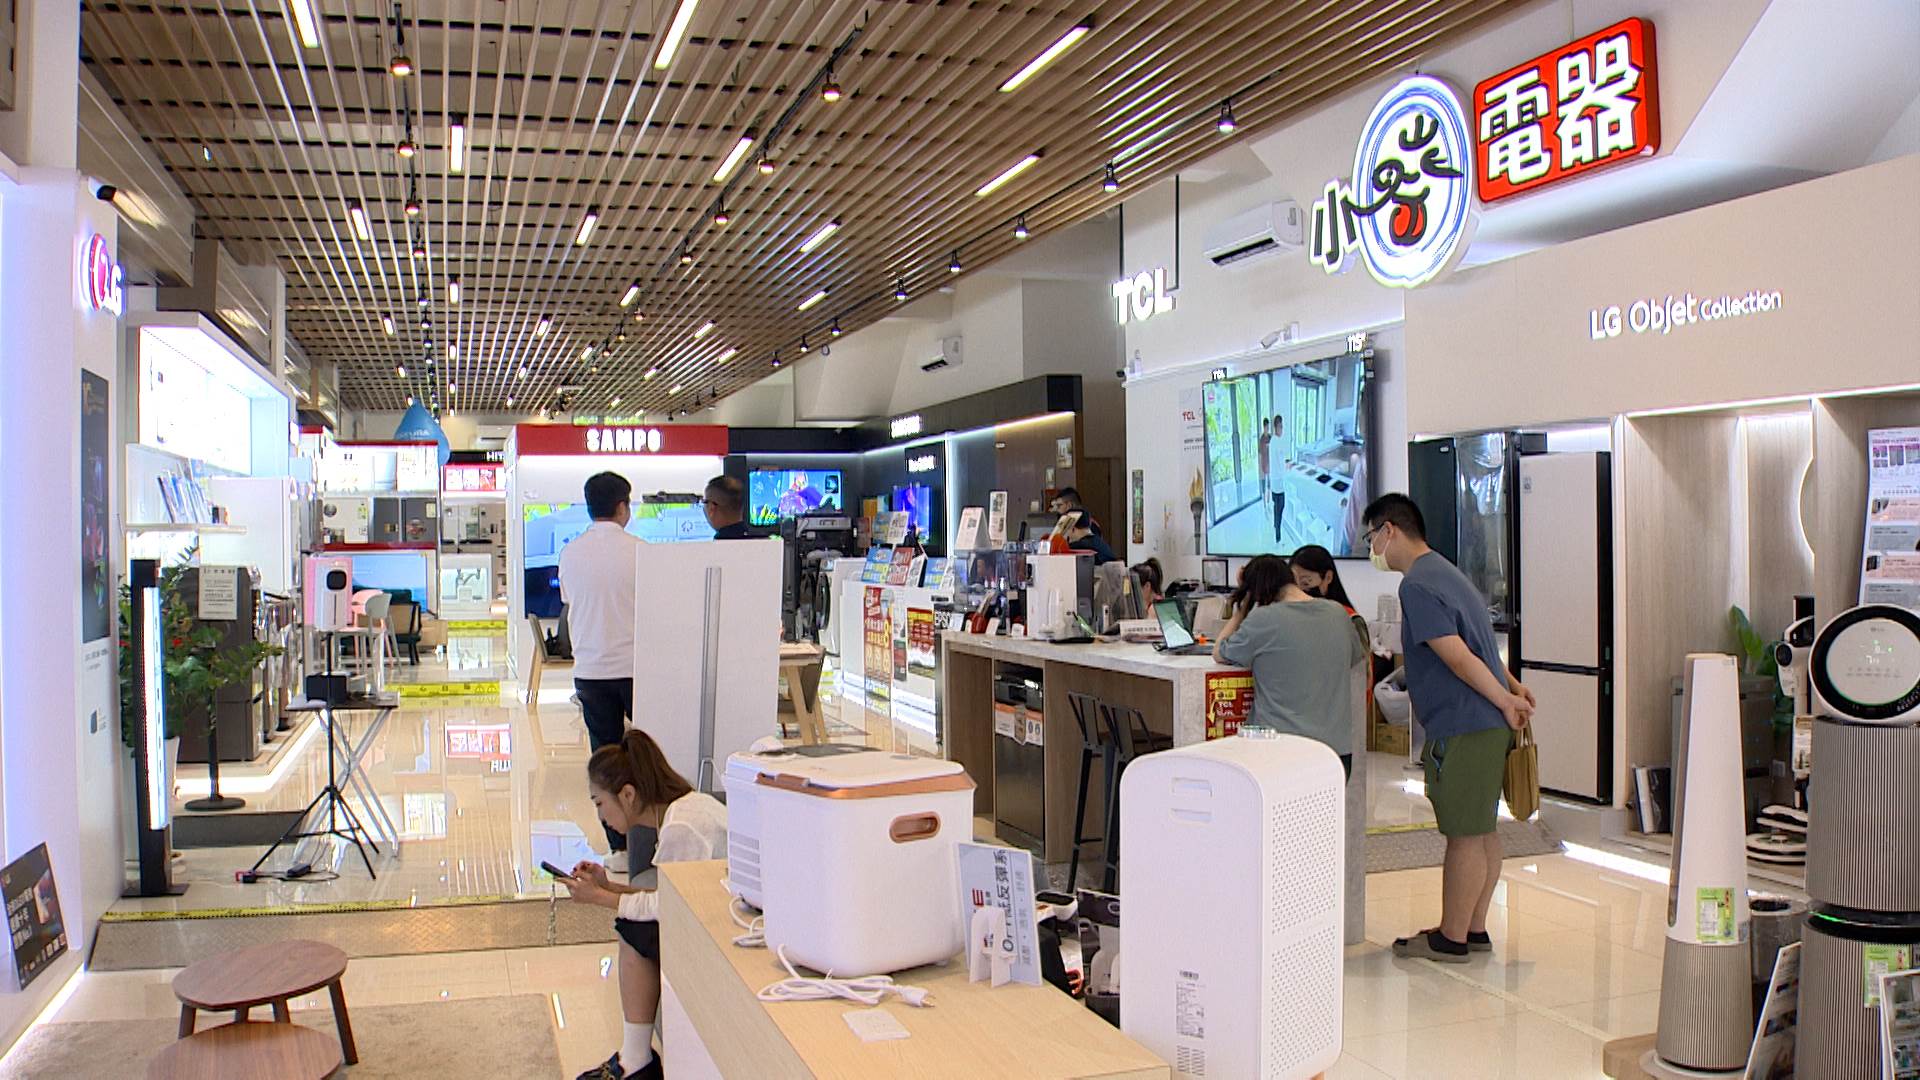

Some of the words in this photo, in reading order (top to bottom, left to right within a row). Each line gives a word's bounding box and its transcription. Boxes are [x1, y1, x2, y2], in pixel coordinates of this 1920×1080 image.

[1480, 34, 1643, 184] 電器
[1112, 268, 1175, 325] TCL
[1590, 306, 1622, 340] LG
[585, 428, 663, 452] SAMPO
